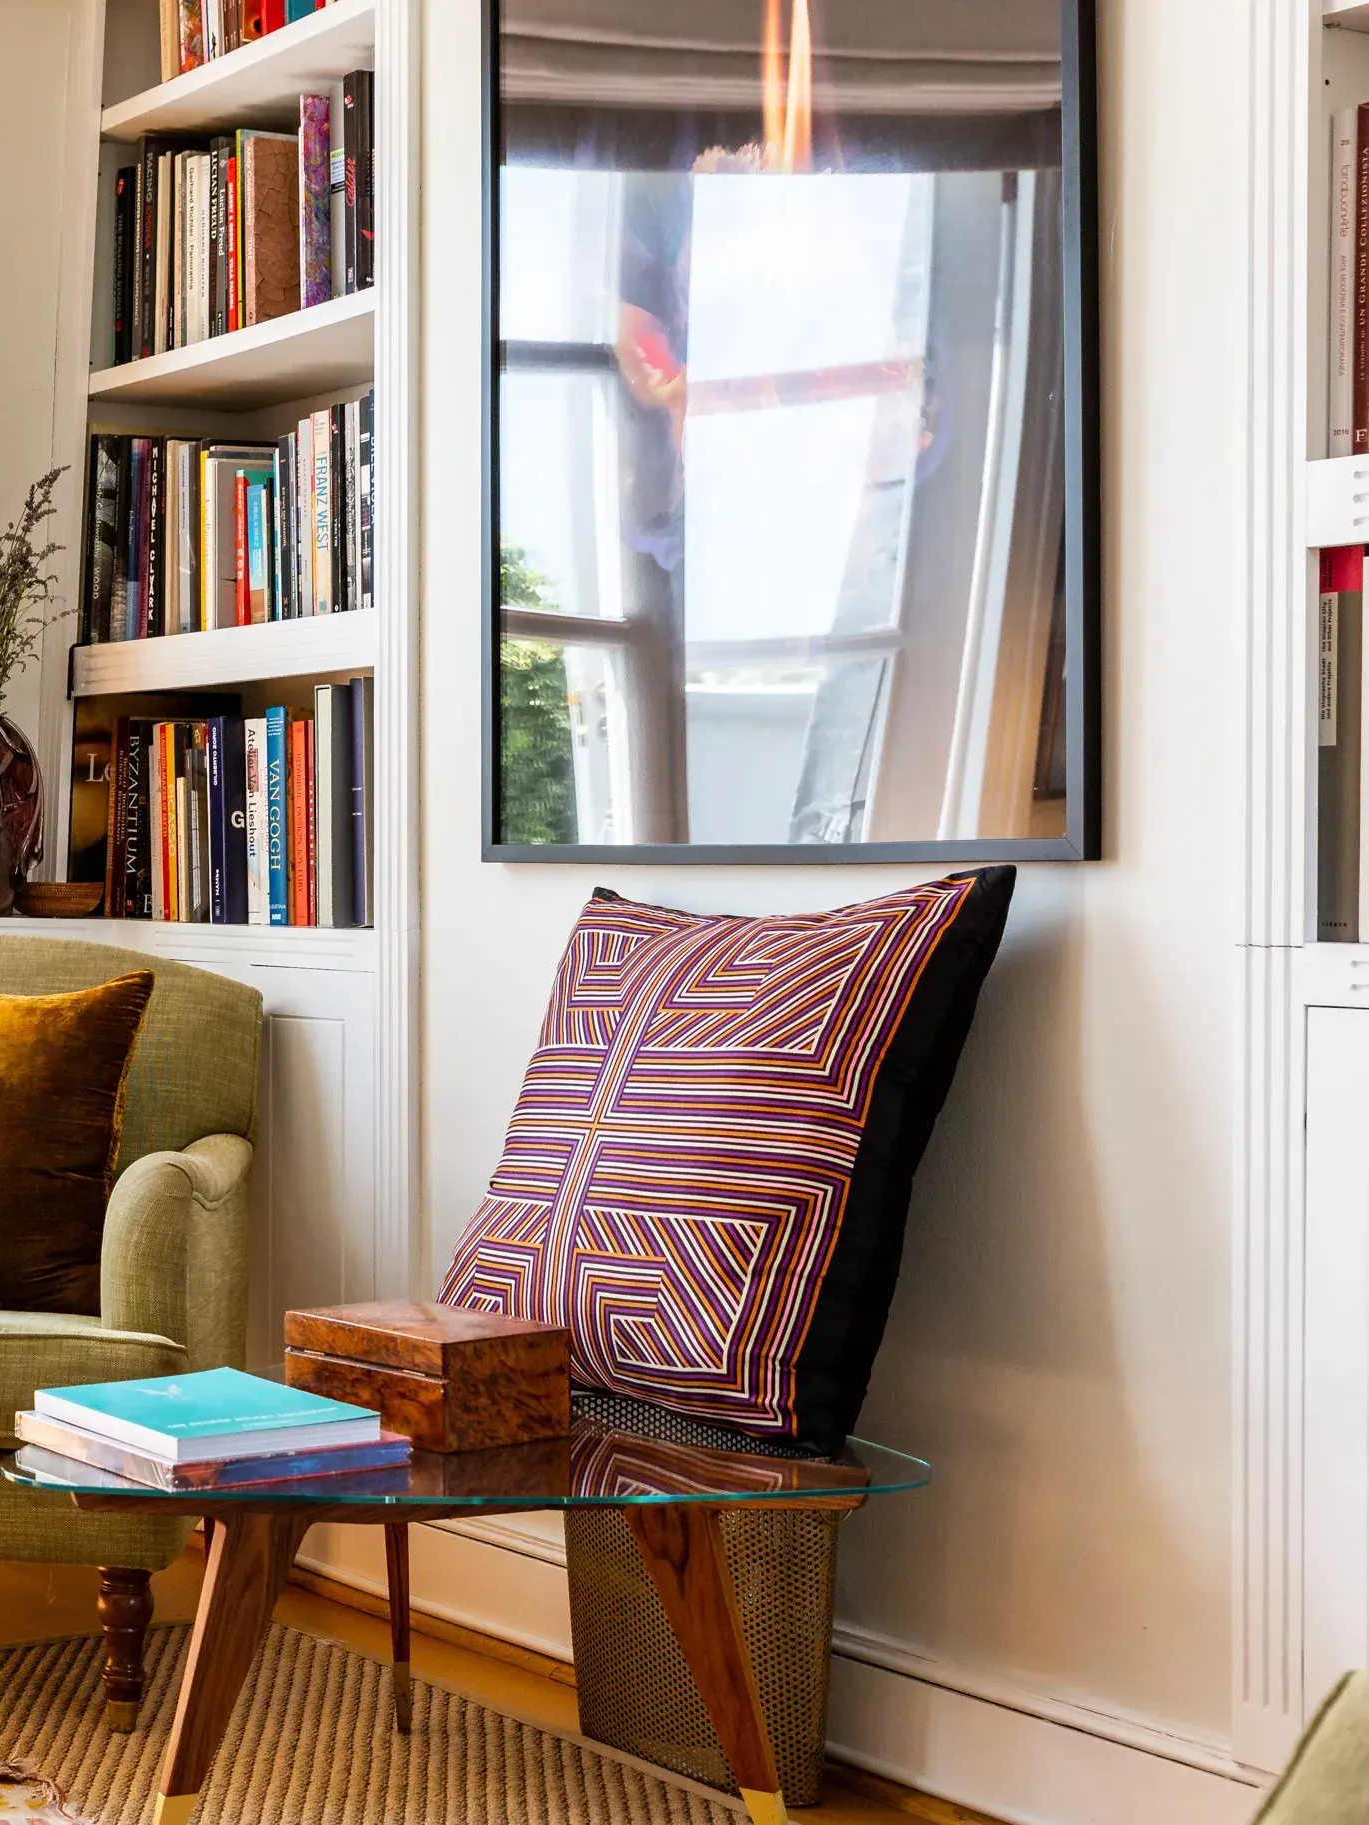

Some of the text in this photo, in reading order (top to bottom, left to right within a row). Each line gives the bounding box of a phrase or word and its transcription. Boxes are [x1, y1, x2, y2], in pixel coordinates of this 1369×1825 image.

[145, 152, 154, 203] FACING
[211, 150, 219, 197] LUCIAN
[245, 146, 253, 169] Andy
[343, 156, 356, 207] Calder
[1359, 147, 1369, 247] COLLEZIONISTA
[1339, 255, 1347, 273] ARTE
[1339, 273, 1347, 309] MODERNA
[1338, 315, 1346, 377] CONTEMPORANEA
[1332, 428, 1351, 436] 2016
[315, 456, 329, 553] FRANZ WEST
[94, 502, 104, 559] Goldsworthy
[92, 566, 100, 600] WOOD
[126, 734, 140, 875] BYZANTIUM
[163, 801, 169, 812] OF
[246, 728, 257, 858] Atelier Van Lieshout
[269, 758, 281, 872] VAN GOGH
[167, 783, 176, 858] PICASSO
